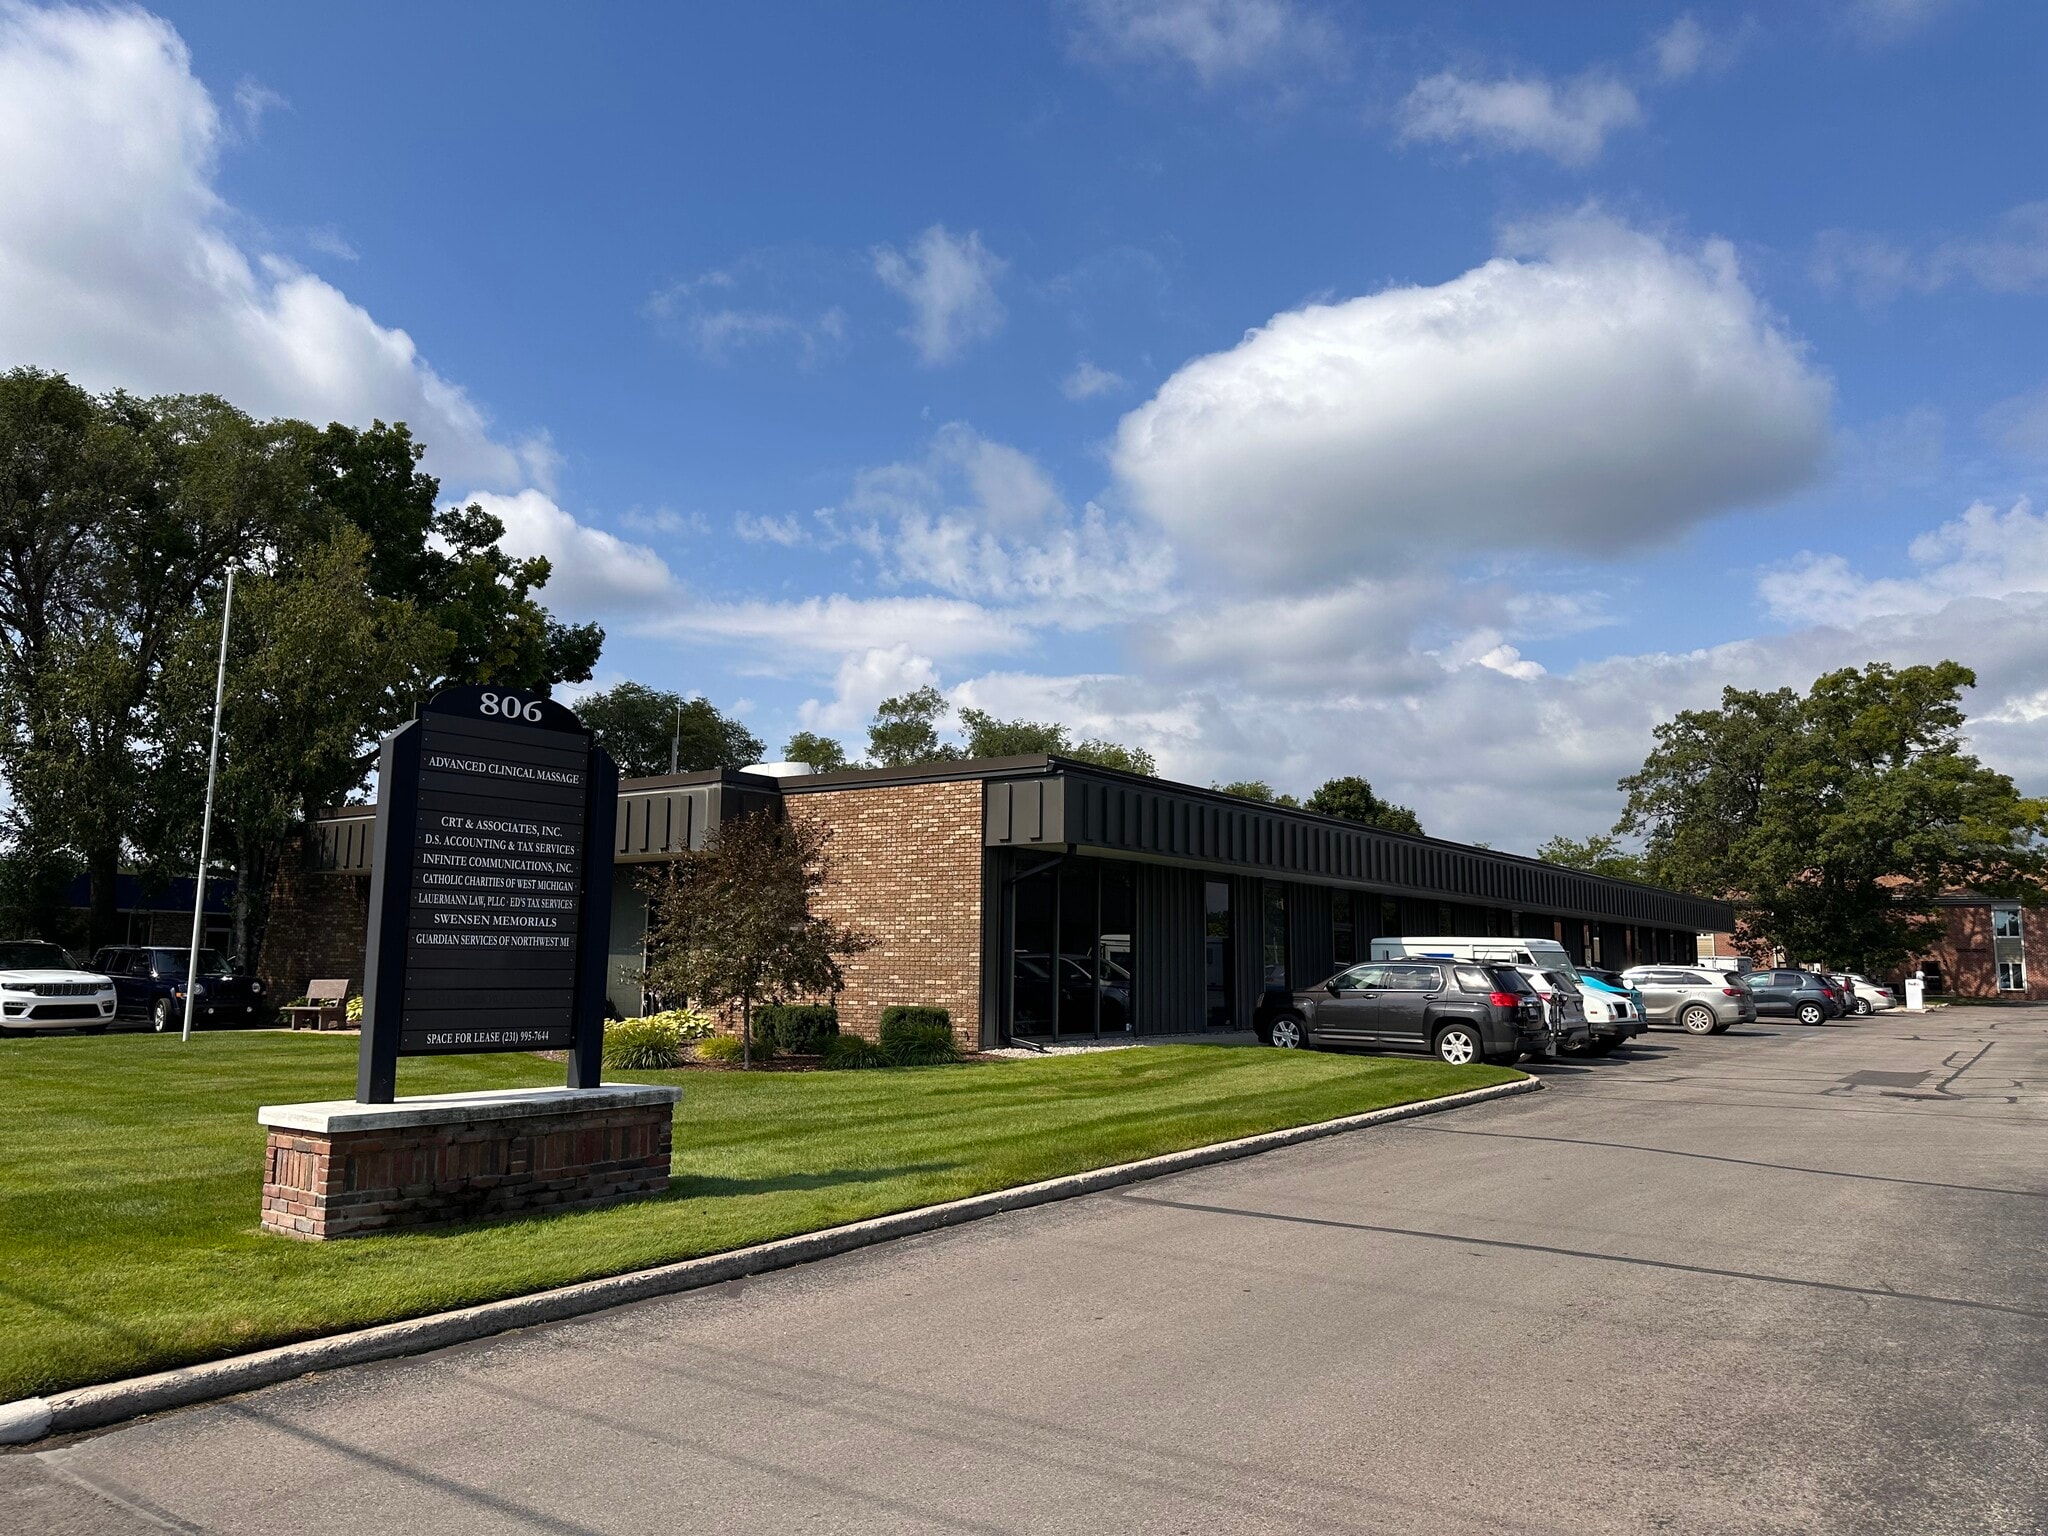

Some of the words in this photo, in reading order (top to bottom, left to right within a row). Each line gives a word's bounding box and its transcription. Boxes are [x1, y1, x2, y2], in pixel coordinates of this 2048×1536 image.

[479, 692, 543, 722] 806
[428, 756, 486, 773] ADVANCED
[488, 763, 535, 779] CLINICAL
[536, 770, 579, 784] MASSAGE
[441, 816, 464, 829] CRT
[465, 818, 474, 829] &
[475, 820, 540, 838] ASSOCIATES,
[541, 825, 563, 837] INC.
[425, 833, 442, 845] D.S.
[443, 835, 507, 850] ACCOUNTING
[507, 840, 515, 850] &
[516, 841, 534, 852] TAX
[535, 842, 575, 855] SERVICES
[422, 853, 467, 866] INFINITE
[468, 856, 555, 874] COMMUNICATIONS,
[555, 863, 574, 874] INC.
[422, 873, 464, 886] CATHOLIC
[464, 875, 505, 888] CHARITIES
[505, 877, 516, 888] OF
[516, 878, 537, 890] WEST
[537, 880, 574, 892] MICHIGAN
[418, 893, 468, 905] LAUERMANN
[468, 895, 486, 908] LAW,
[487, 896, 505, 907] PLLC
[510, 897, 526, 908] ED'S
[527, 898, 540, 908] TAX
[541, 898, 573, 910] SERVICES
[434, 913, 491, 925] SWENSEN
[492, 915, 557, 927] MEMORIALS
[415, 933, 460, 945] GUARDIAN
[460, 935, 498, 946] SERVICES
[499, 935, 510, 946] OF
[510, 936, 560, 947] NORTHWEST
[560, 937, 570, 947] MI
[426, 1033, 453, 1045] SPACE
[454, 1032, 472, 1043] FOR
[473, 1031, 500, 1043] LEASE
[502, 1031, 519, 1045] (231)
[520, 1030, 549, 1041] 995-7644
